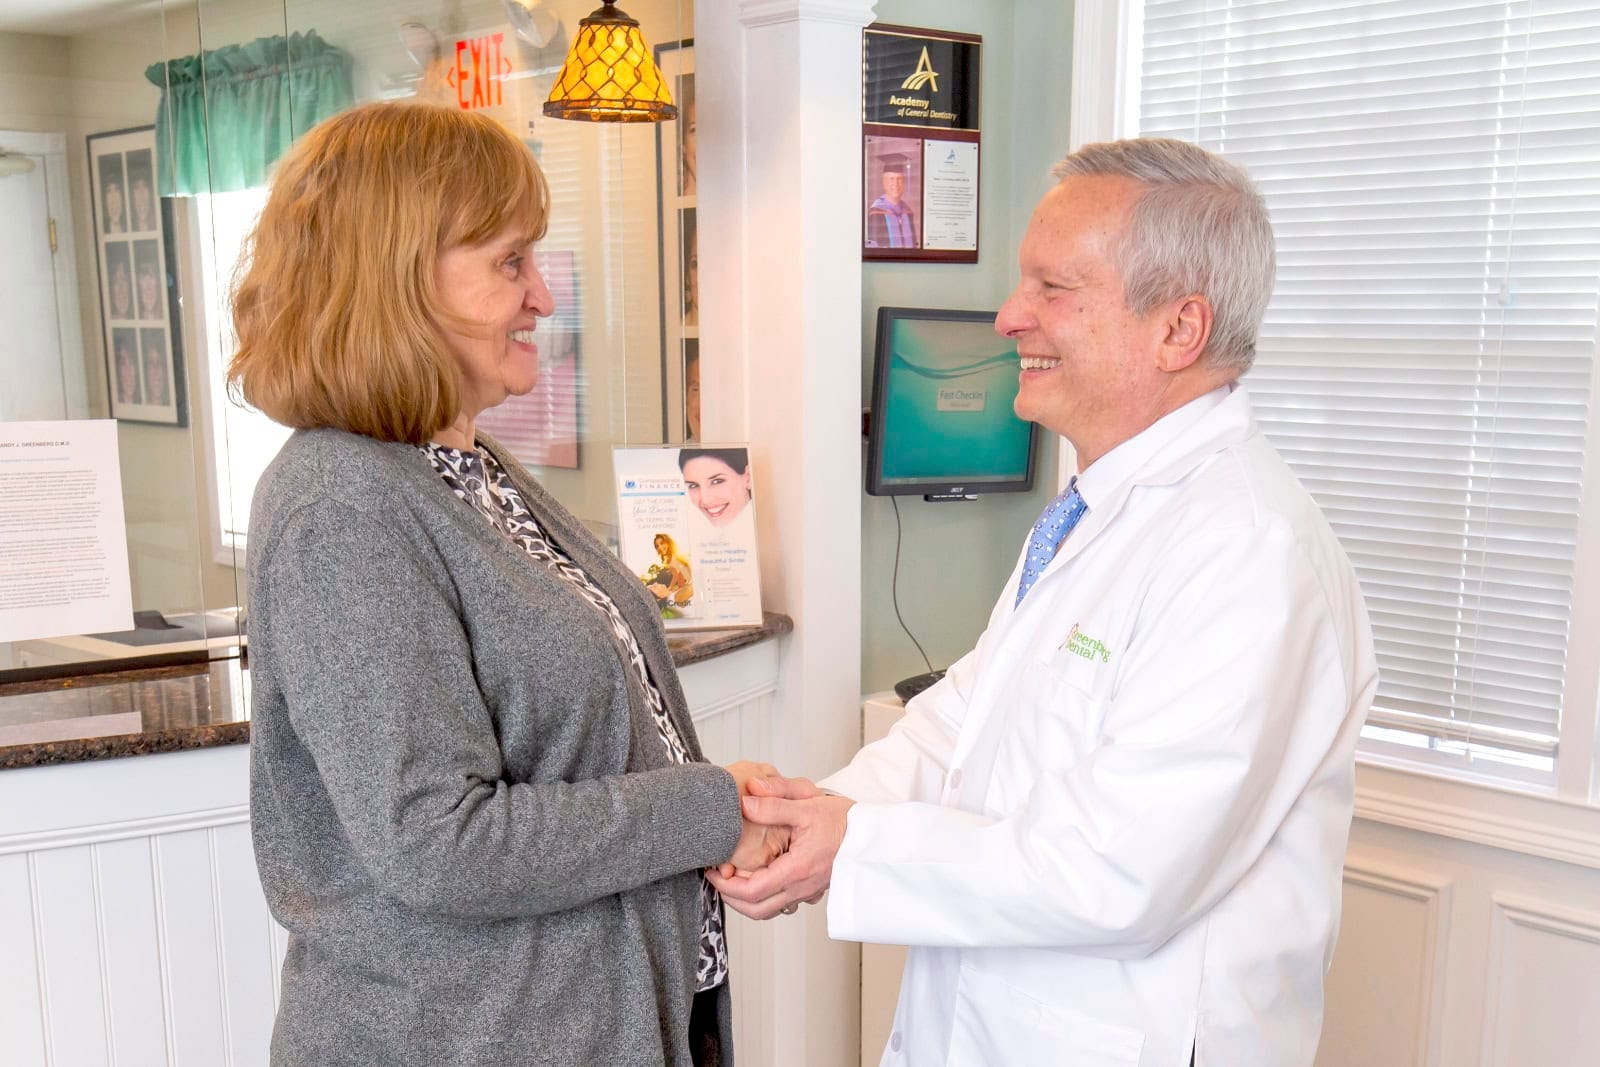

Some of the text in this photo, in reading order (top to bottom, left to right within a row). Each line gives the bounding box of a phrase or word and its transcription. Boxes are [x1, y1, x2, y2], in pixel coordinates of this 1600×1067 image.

[456, 32, 504, 109] EXIT
[889, 95, 930, 109] Academy
[897, 107, 958, 121] of General Dentistry
[940, 390, 954, 400] Fast
